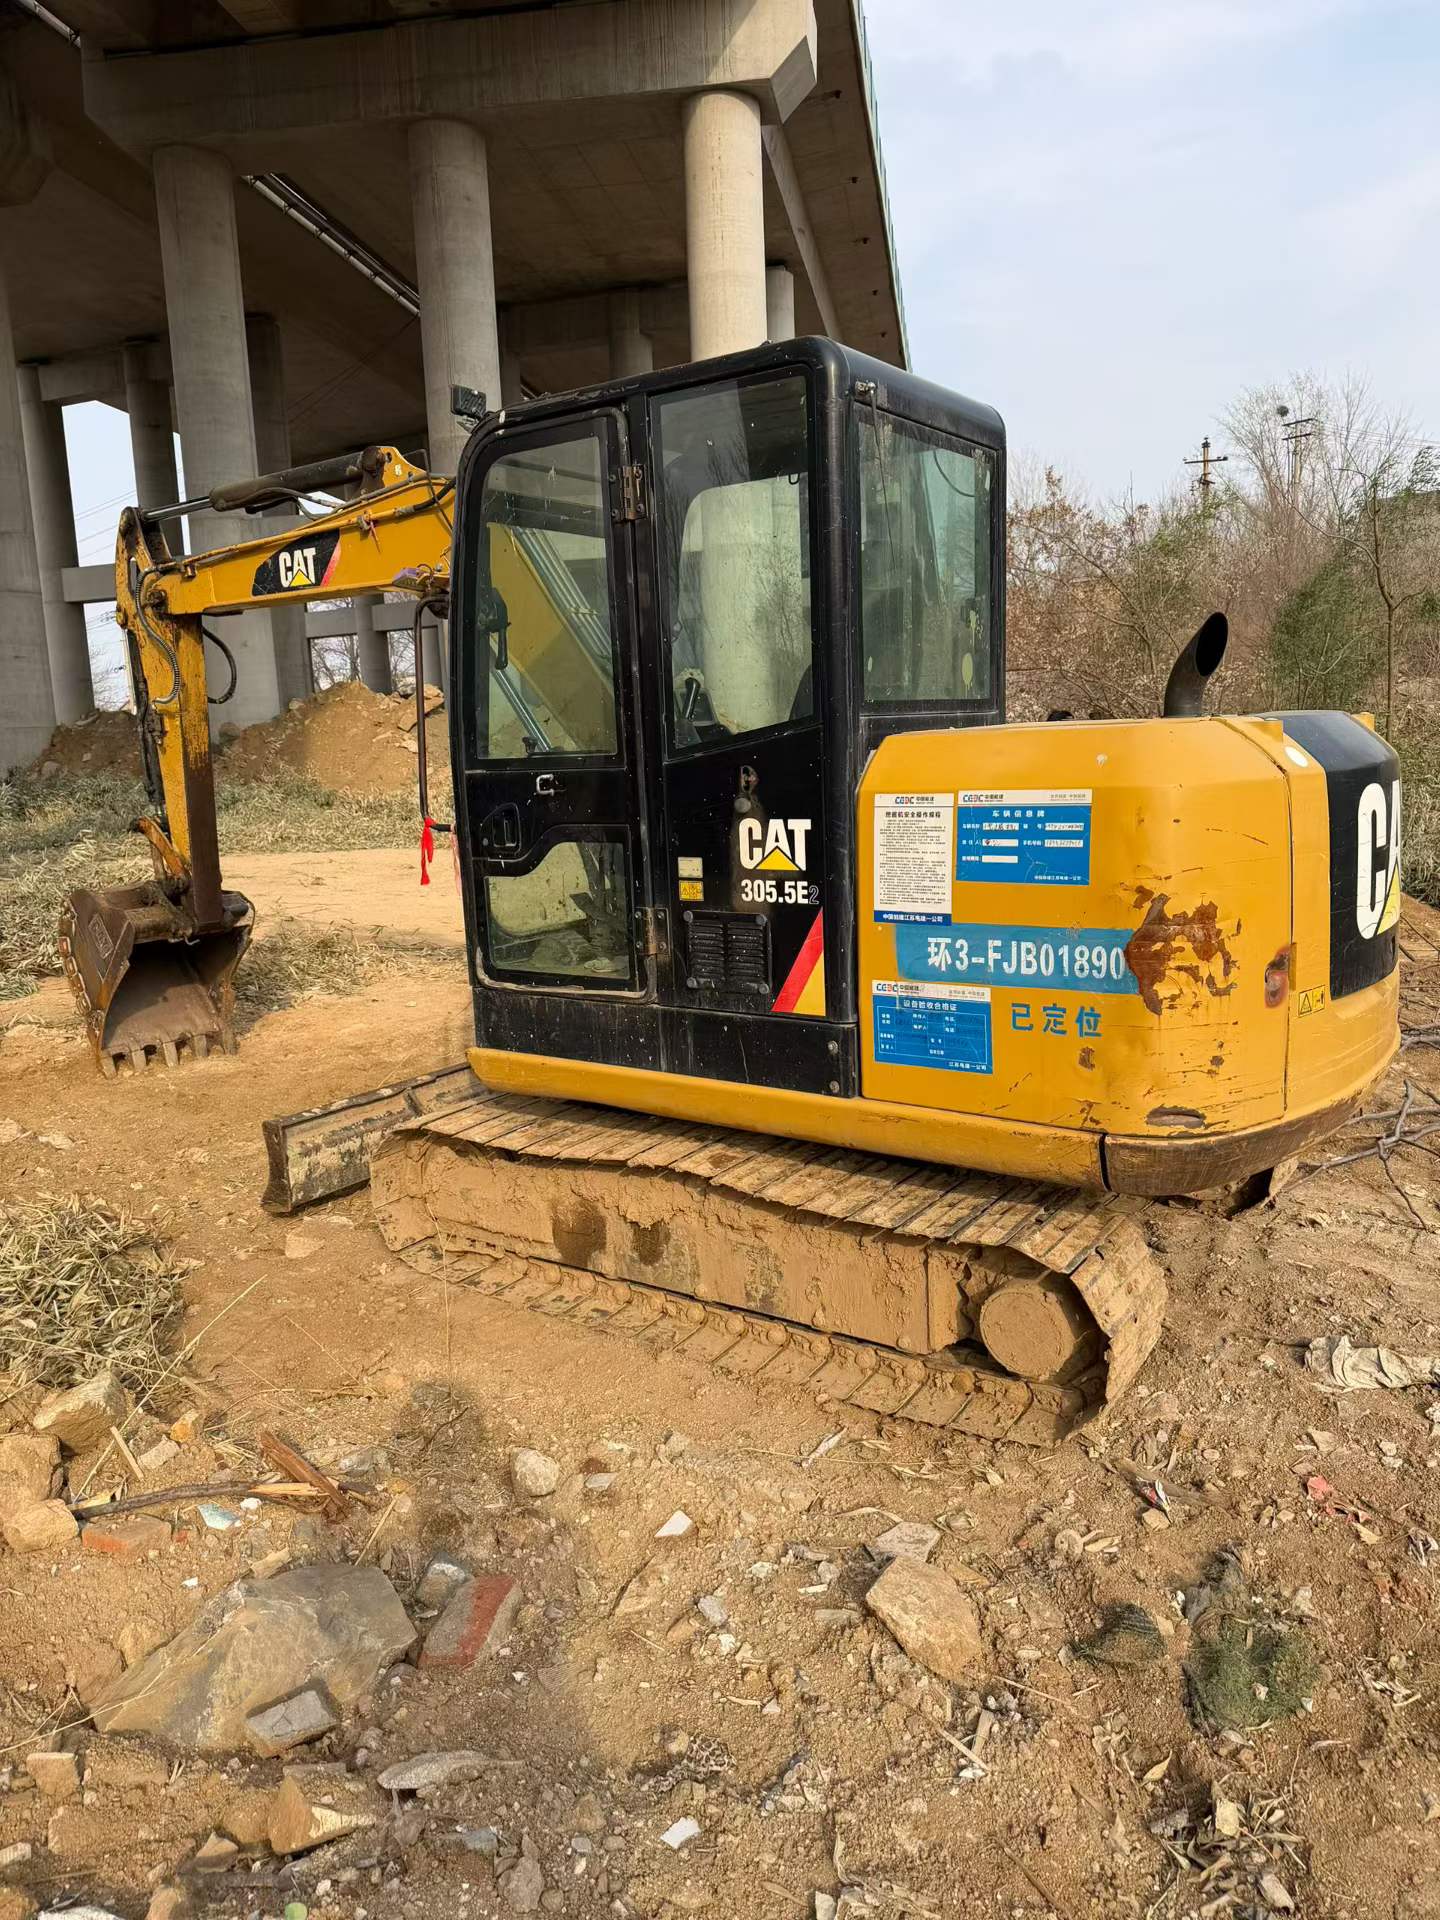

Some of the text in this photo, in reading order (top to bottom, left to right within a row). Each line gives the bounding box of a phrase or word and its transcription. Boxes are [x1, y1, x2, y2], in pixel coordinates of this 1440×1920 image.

[279, 547, 316, 588] CAT
[992, 809, 1045, 818] 车辆信息牌
[738, 817, 812, 872] CAT
[740, 879, 820, 905] 305.5E2
[927, 937, 1126, 980] 环3-FJB01890
[903, 999, 957, 1011] 设备验收合格证
[1011, 1002, 1103, 1037] 已定位
